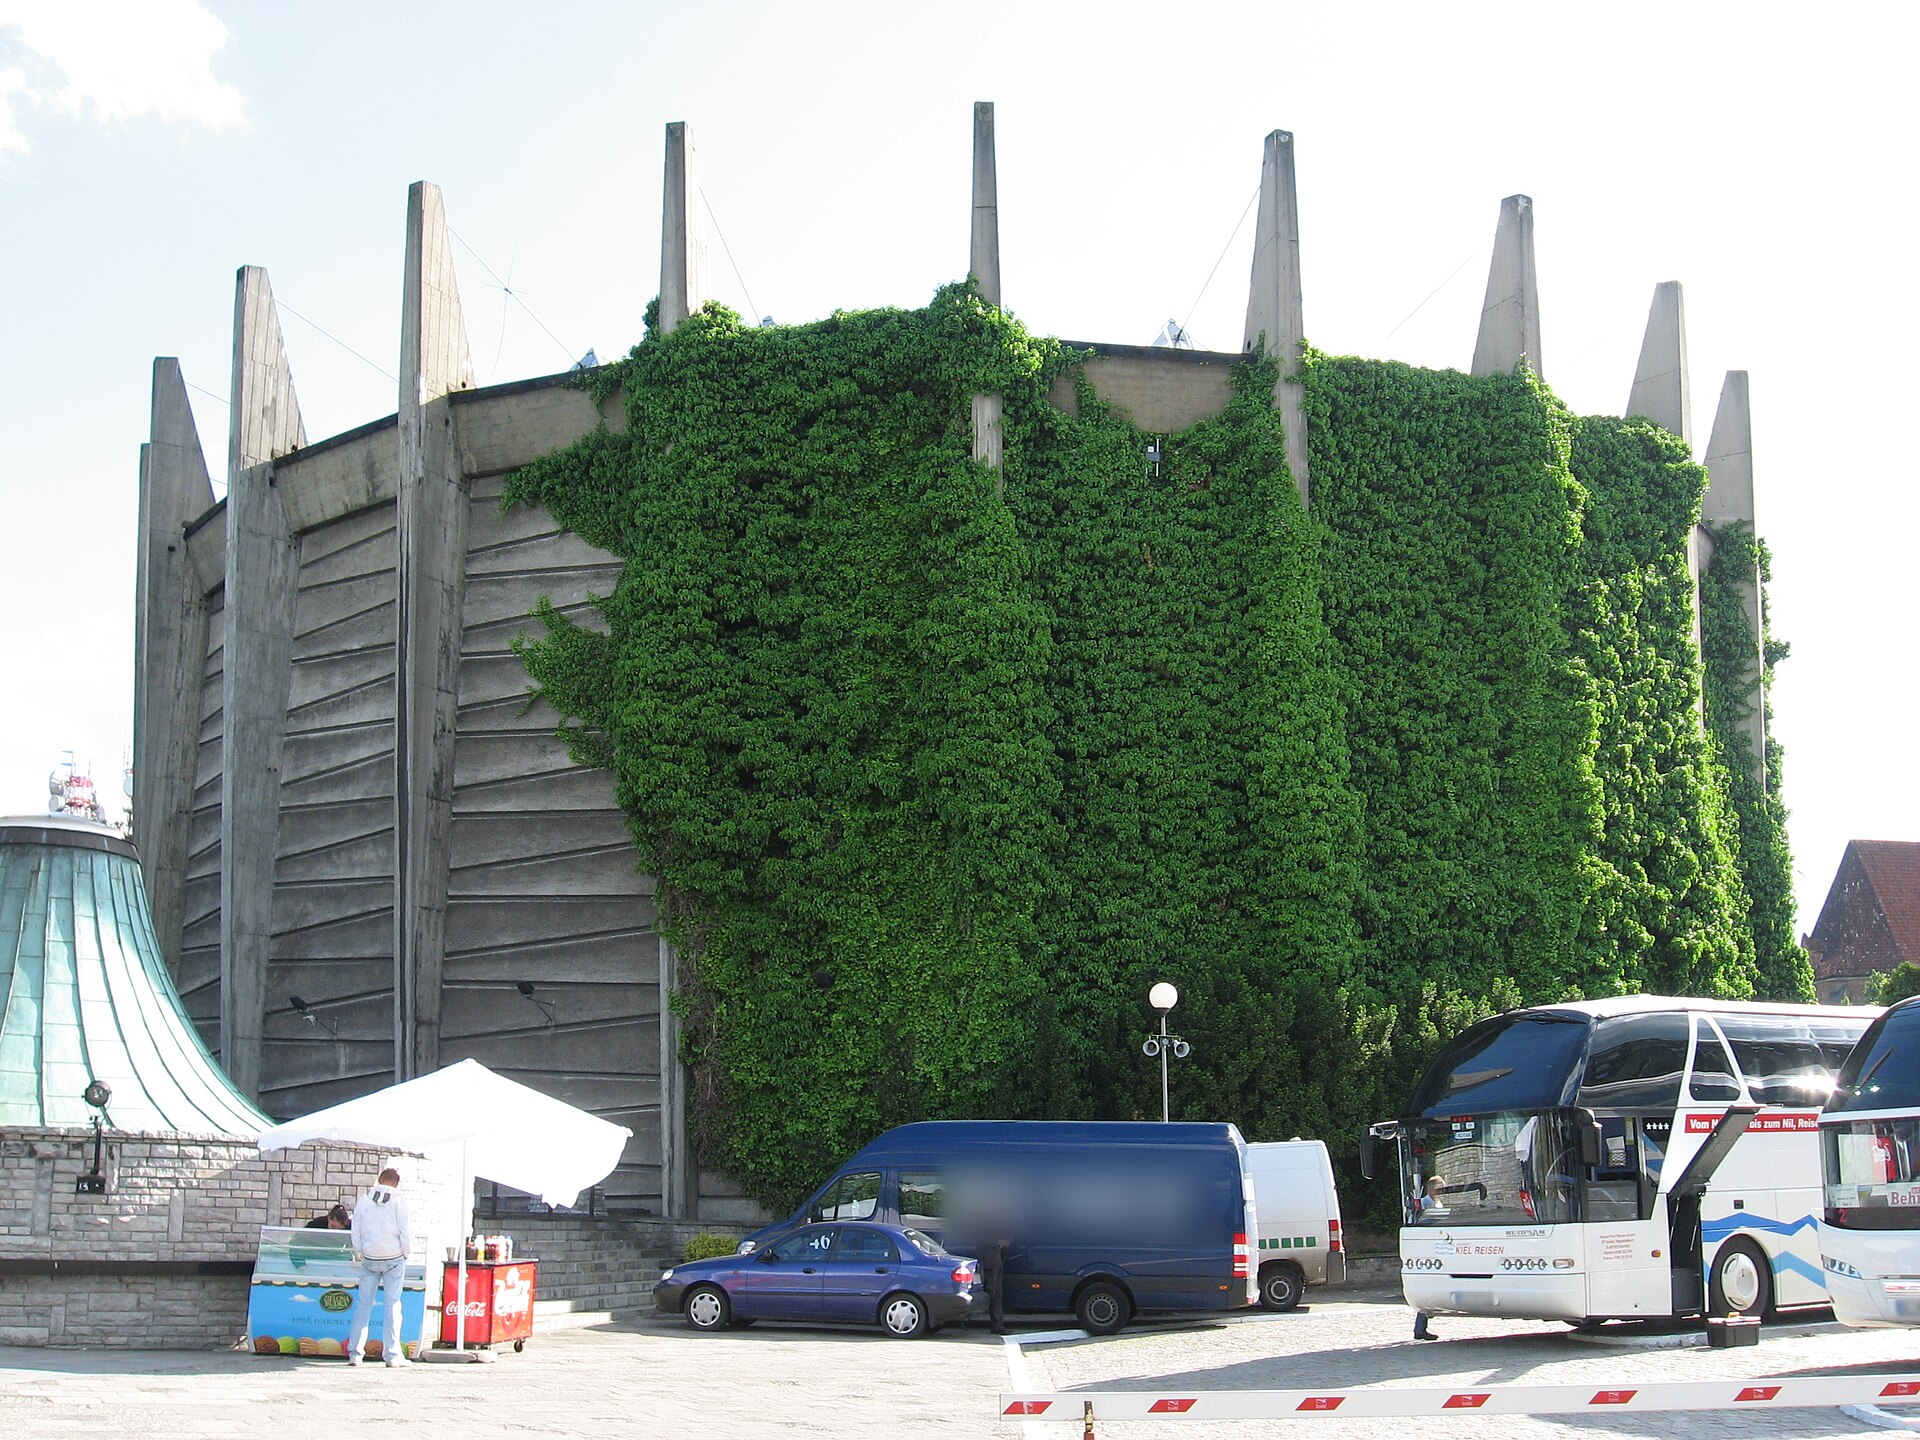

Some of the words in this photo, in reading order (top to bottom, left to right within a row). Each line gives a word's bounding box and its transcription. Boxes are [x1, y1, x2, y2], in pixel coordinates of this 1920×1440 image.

[1690, 1118, 1710, 1129] Vom
[1763, 1120, 1780, 1128] zum
[1782, 1118, 1796, 1130] Nil,
[1838, 1209, 1847, 1223] 2
[1455, 1246, 1472, 1255] KIEL
[1474, 1246, 1505, 1255] REISEN
